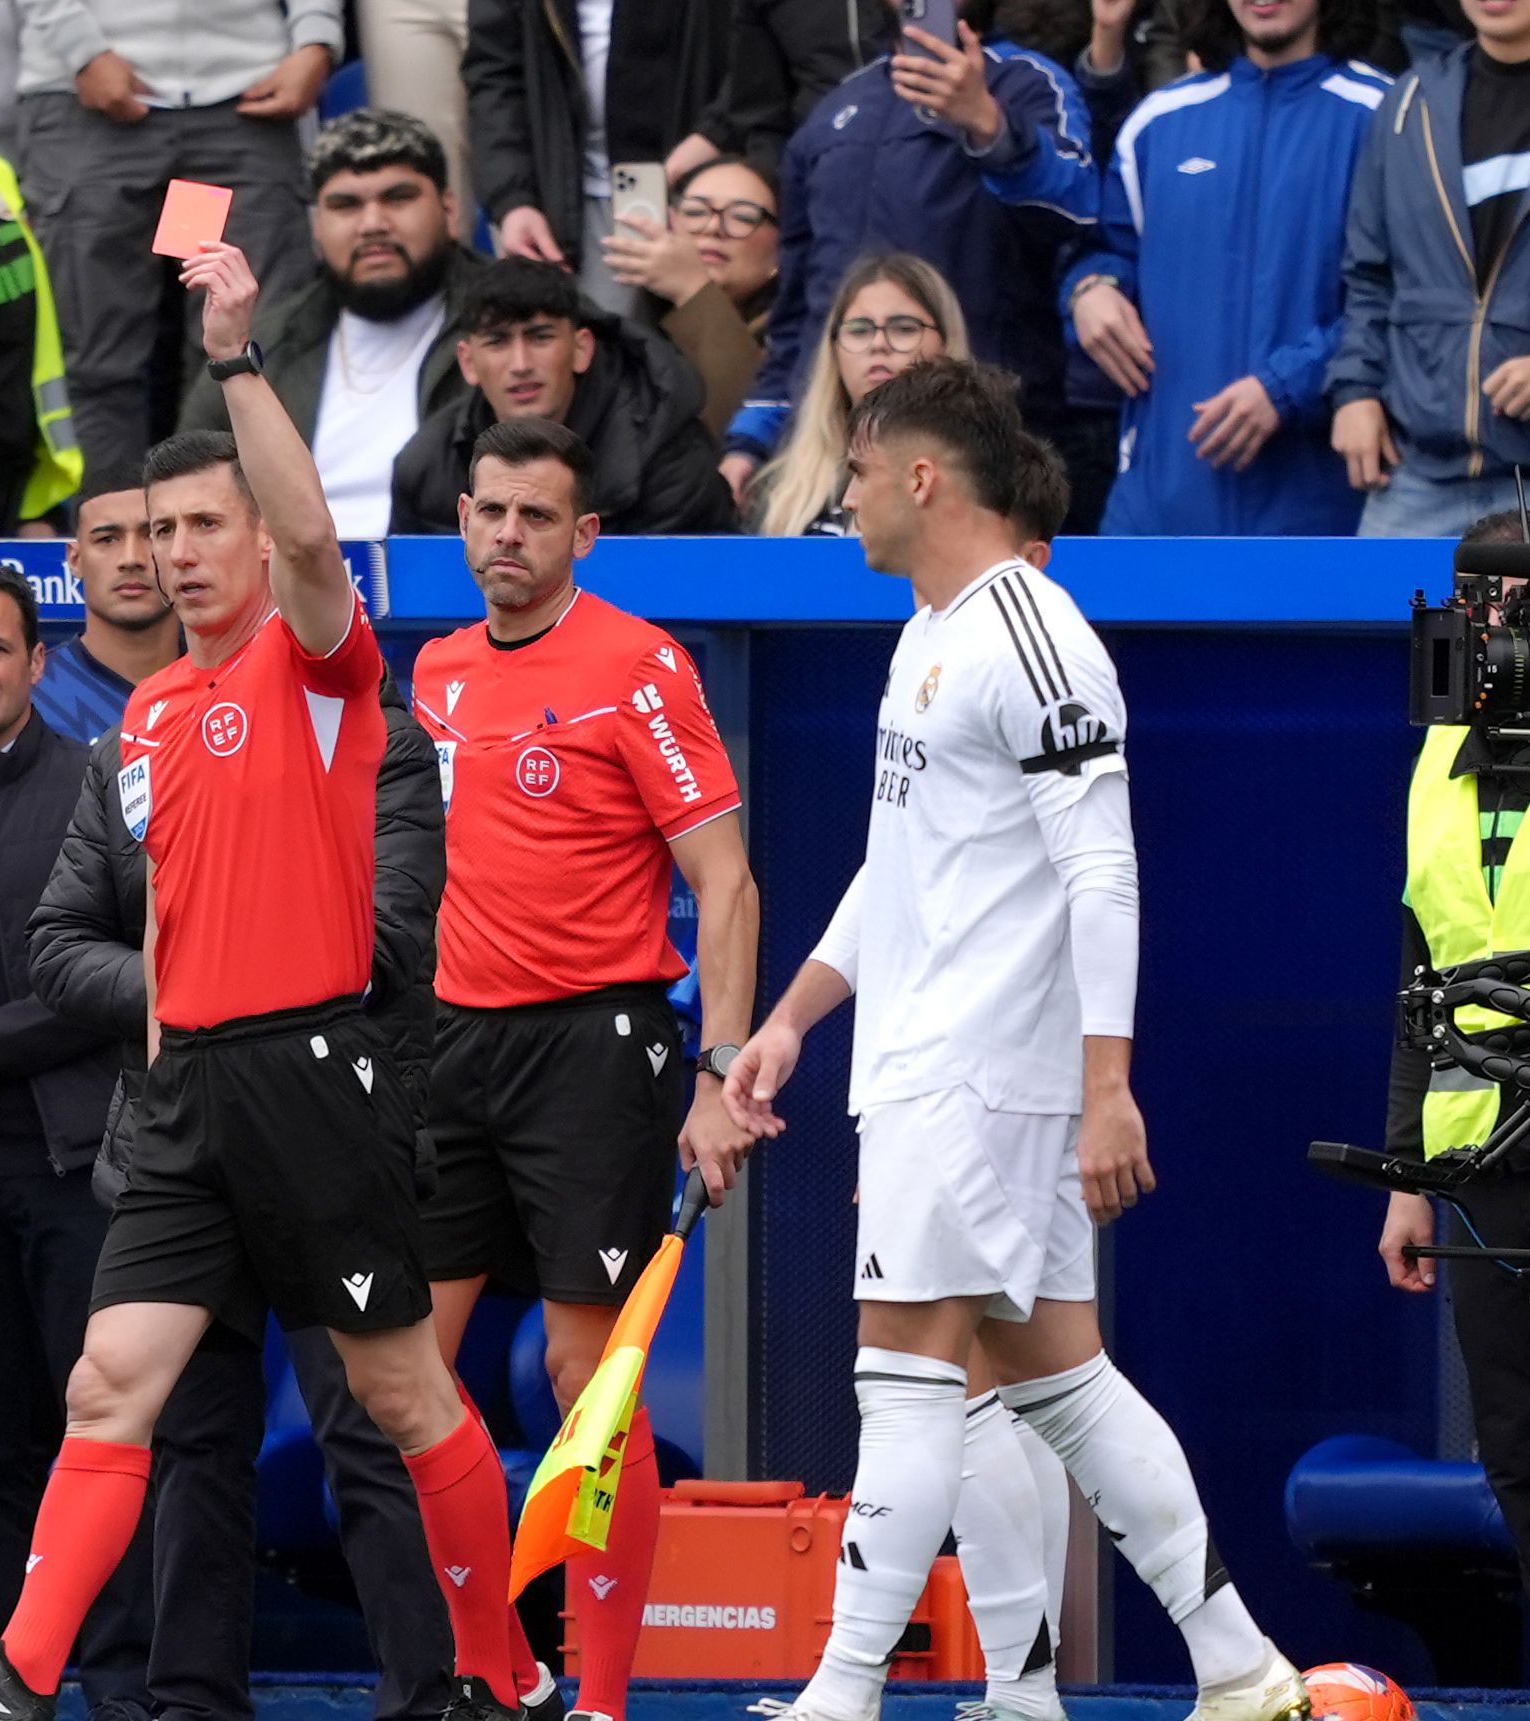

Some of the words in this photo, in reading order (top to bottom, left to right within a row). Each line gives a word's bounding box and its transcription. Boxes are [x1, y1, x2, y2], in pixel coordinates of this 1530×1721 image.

[648, 713, 702, 803] WÜRTH
[121, 764, 146, 795] FIFA
[593, 1488, 614, 1513] TH
